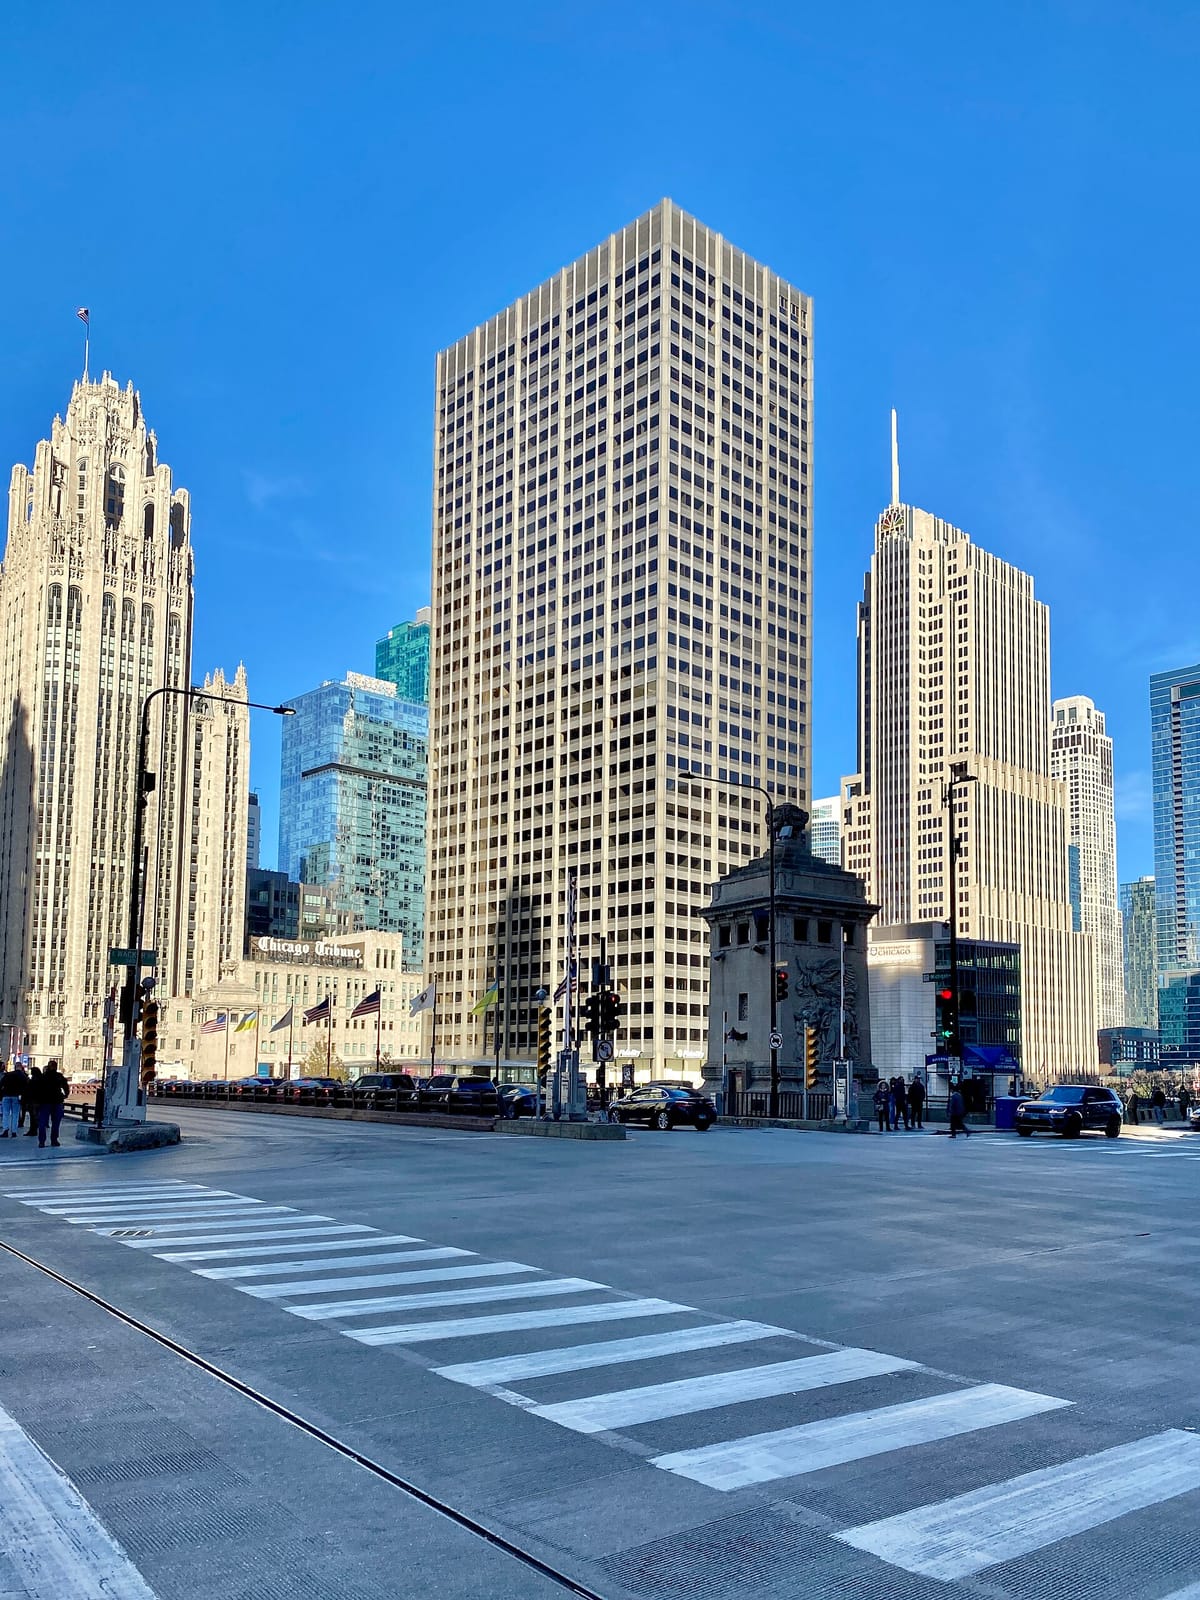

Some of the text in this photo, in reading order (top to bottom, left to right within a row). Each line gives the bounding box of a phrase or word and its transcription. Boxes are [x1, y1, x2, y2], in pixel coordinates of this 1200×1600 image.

[258, 936, 361, 958] Chicago Tribune
[878, 948, 911, 956] CHICAGO
